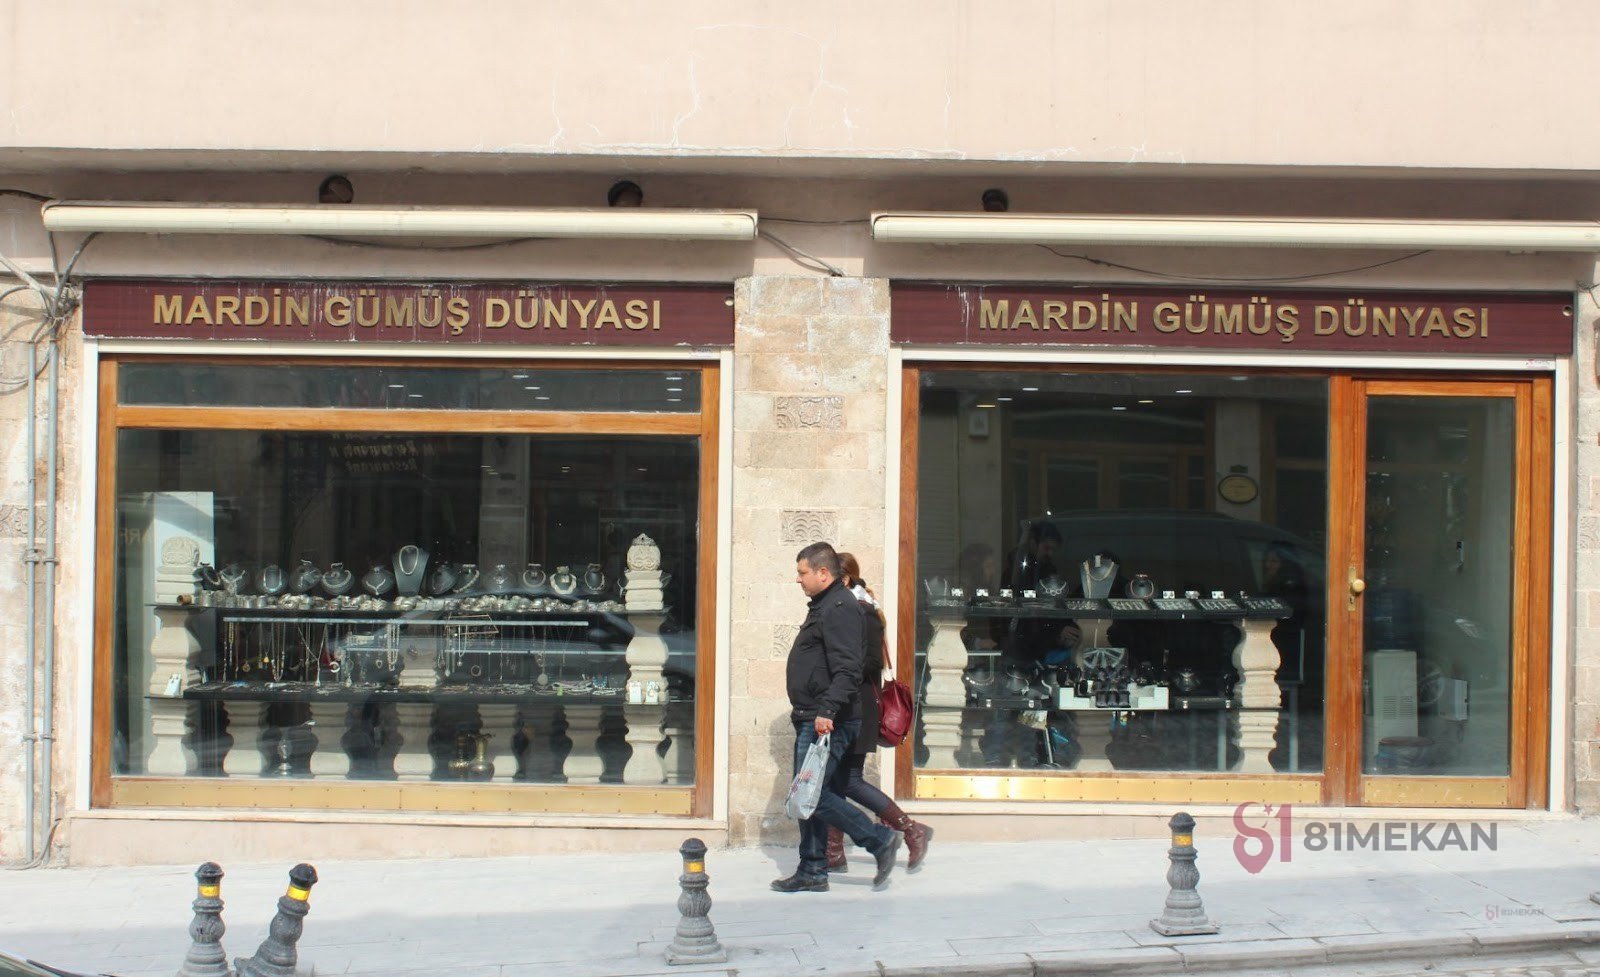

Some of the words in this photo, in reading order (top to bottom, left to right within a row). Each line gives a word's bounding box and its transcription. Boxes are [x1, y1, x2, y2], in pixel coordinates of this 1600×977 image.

[153, 287, 311, 326] MARDİN
[323, 288, 471, 336] GÜMÜŞ
[484, 288, 661, 331] DÜNYASI
[979, 293, 1138, 332] MARDİN
[1152, 294, 1300, 342] GÜMÜŞ
[1314, 298, 1489, 338] DÜNYASI
